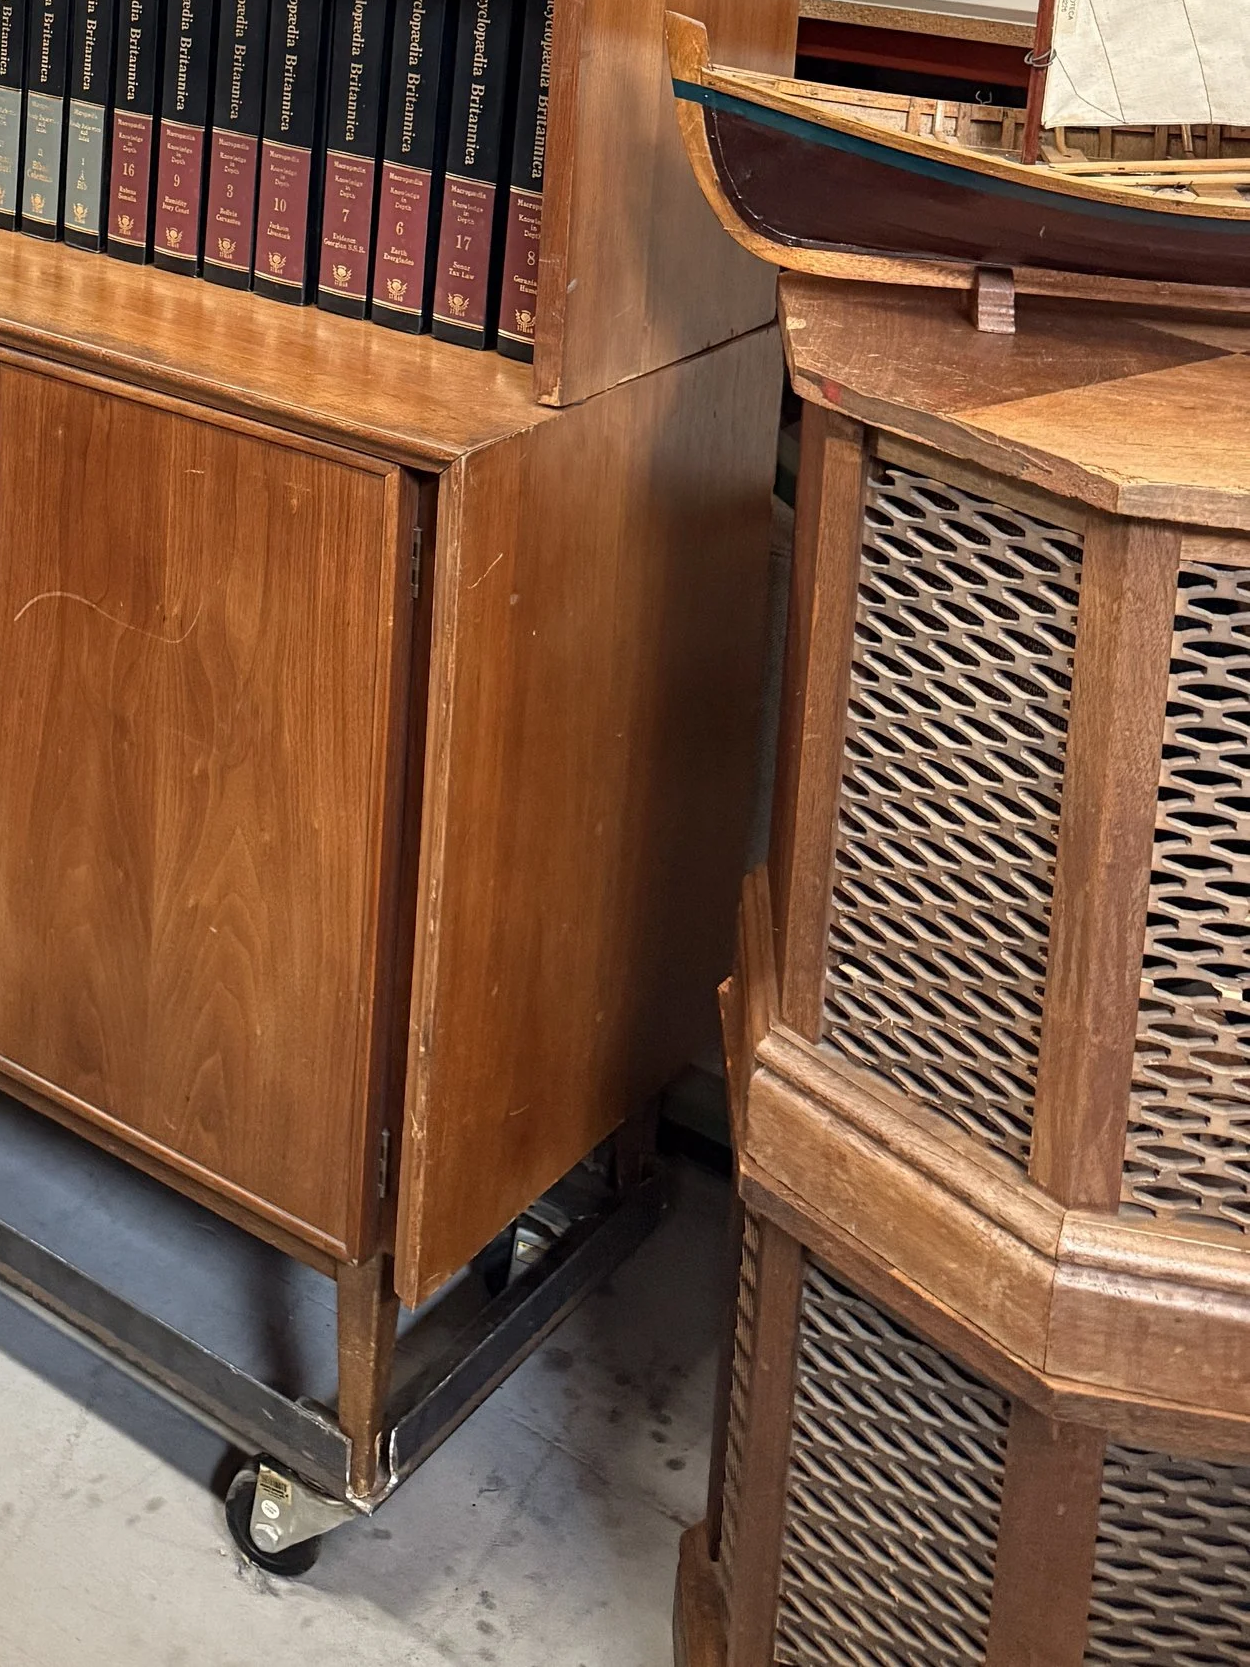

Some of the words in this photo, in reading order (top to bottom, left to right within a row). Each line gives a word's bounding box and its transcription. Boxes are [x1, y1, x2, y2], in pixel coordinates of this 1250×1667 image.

[0, 6, 12, 75] Britannica
[40, 12, 55, 83] Britannica
[83, 19, 97, 90] Britannica
[127, 27, 141, 100] Britannica
[177, 37, 192, 110] Britannica
[230, 44, 246, 119] Britannica
[281, 54, 297, 131] Britannica
[346, 63, 363, 141] Britannica
[402, 72, 420, 153] Britannica
[464, 83, 485, 165] Britannica
[122, 163, 135, 177] 16
[173, 174, 180, 187] 9
[226, 184, 234, 198] 3
[273, 197, 287, 212] 10
[341, 209, 349, 222] 7
[396, 222, 404, 235] 6
[456, 235, 472, 250] 17
[527, 251, 535, 266] 8
